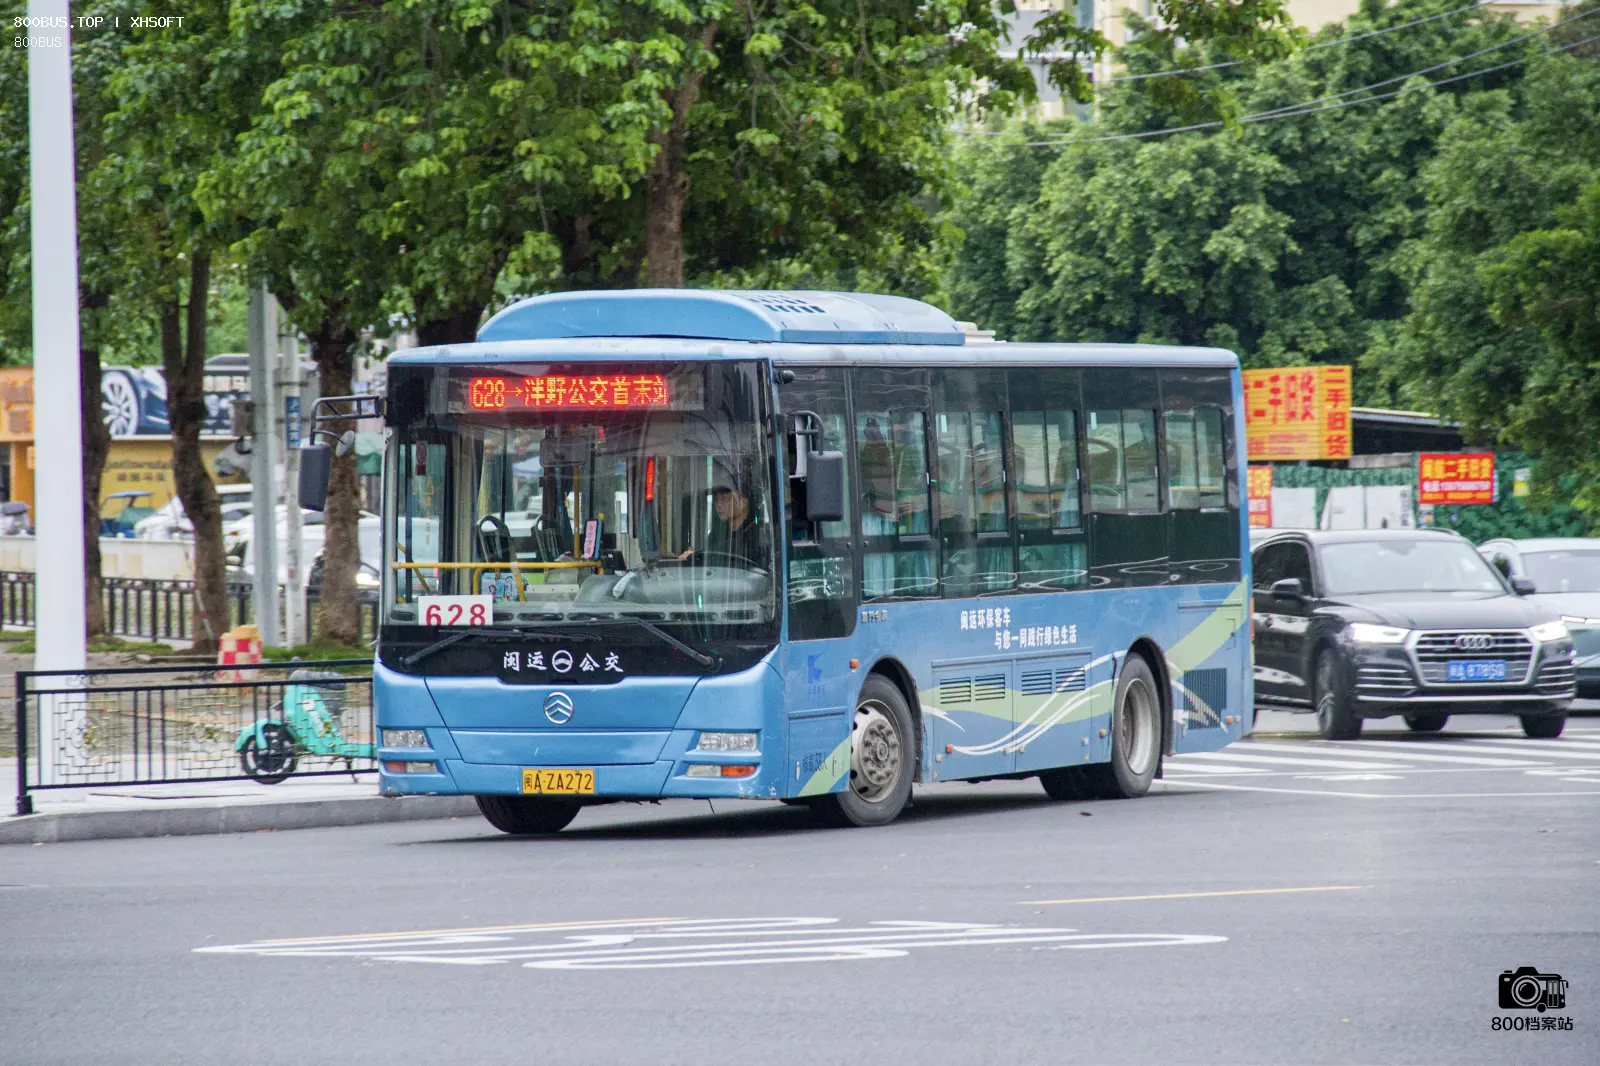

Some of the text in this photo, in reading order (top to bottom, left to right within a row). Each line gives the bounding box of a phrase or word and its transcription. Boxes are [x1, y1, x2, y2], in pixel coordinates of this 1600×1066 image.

[472, 379, 505, 407] 628
[1325, 369, 1347, 456] 二手旧货
[425, 603, 486, 625] 628
[960, 608, 1011, 631] 闽运环保客车
[994, 624, 1077, 650] 与您一同践行绿色生活
[503, 651, 624, 673] 闽运 公交
